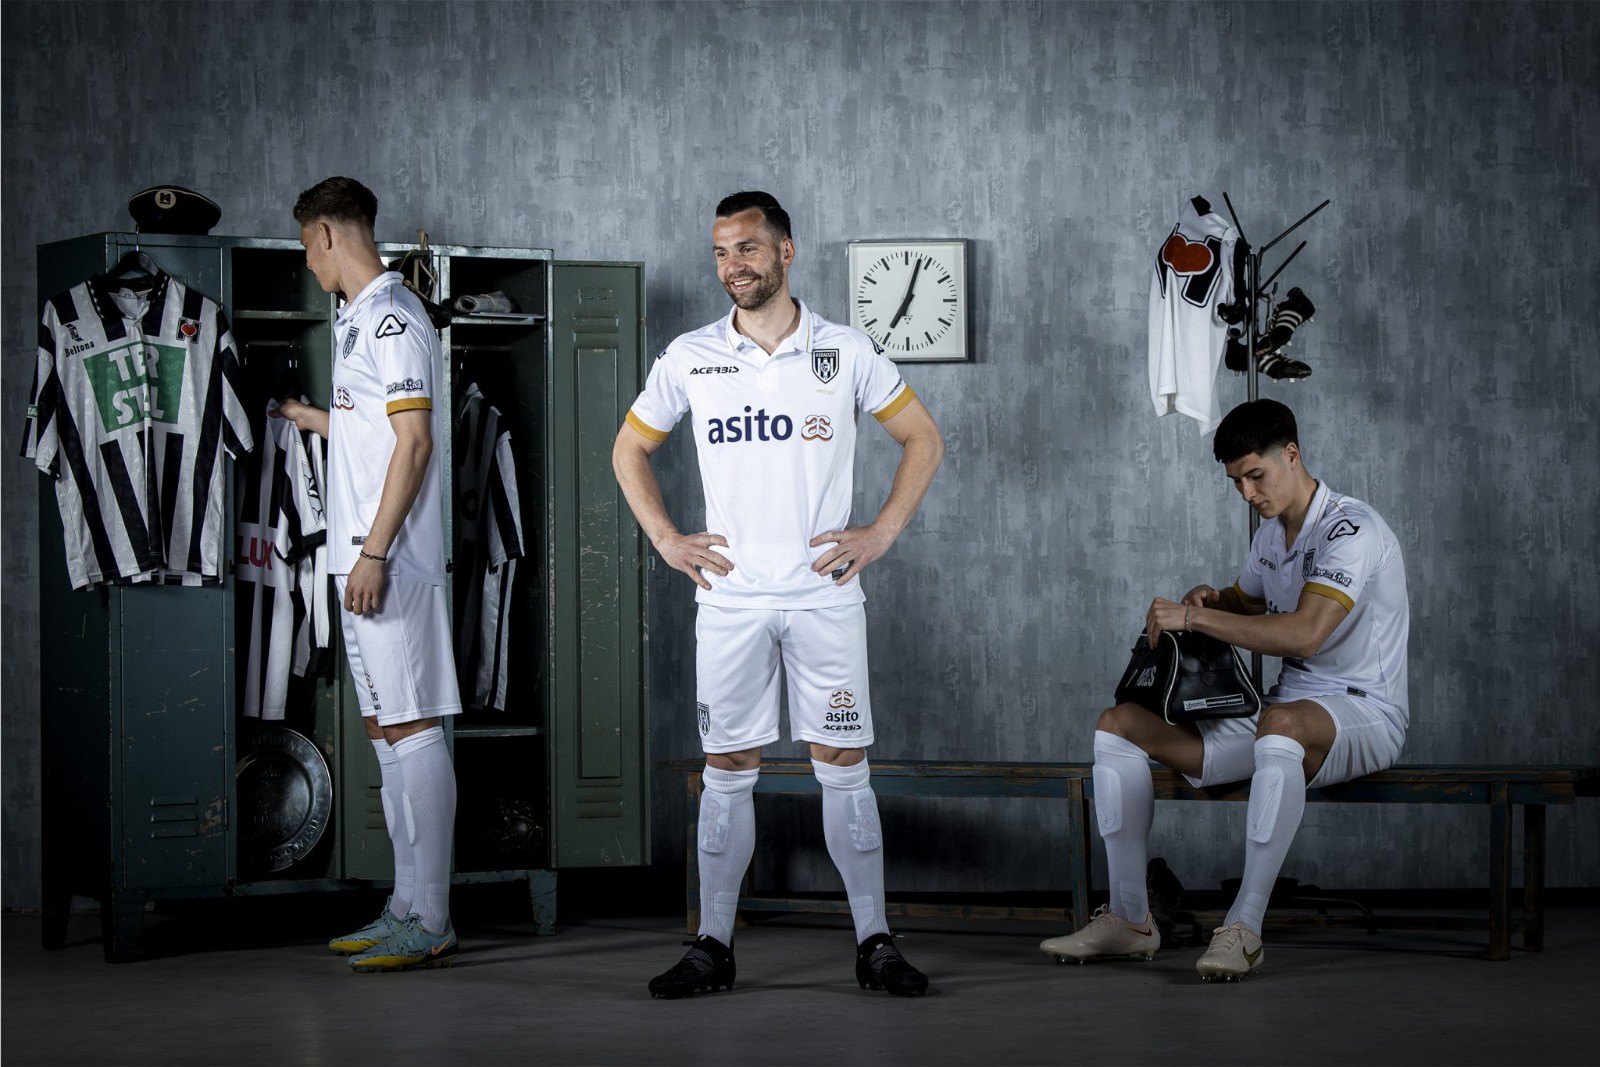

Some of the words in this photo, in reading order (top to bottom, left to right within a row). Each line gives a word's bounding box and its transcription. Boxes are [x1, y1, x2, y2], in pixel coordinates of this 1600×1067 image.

[65, 341, 95, 358] Beltona
[108, 343, 160, 382] TER
[708, 405, 793, 445] asito
[825, 709, 859, 723] asito
